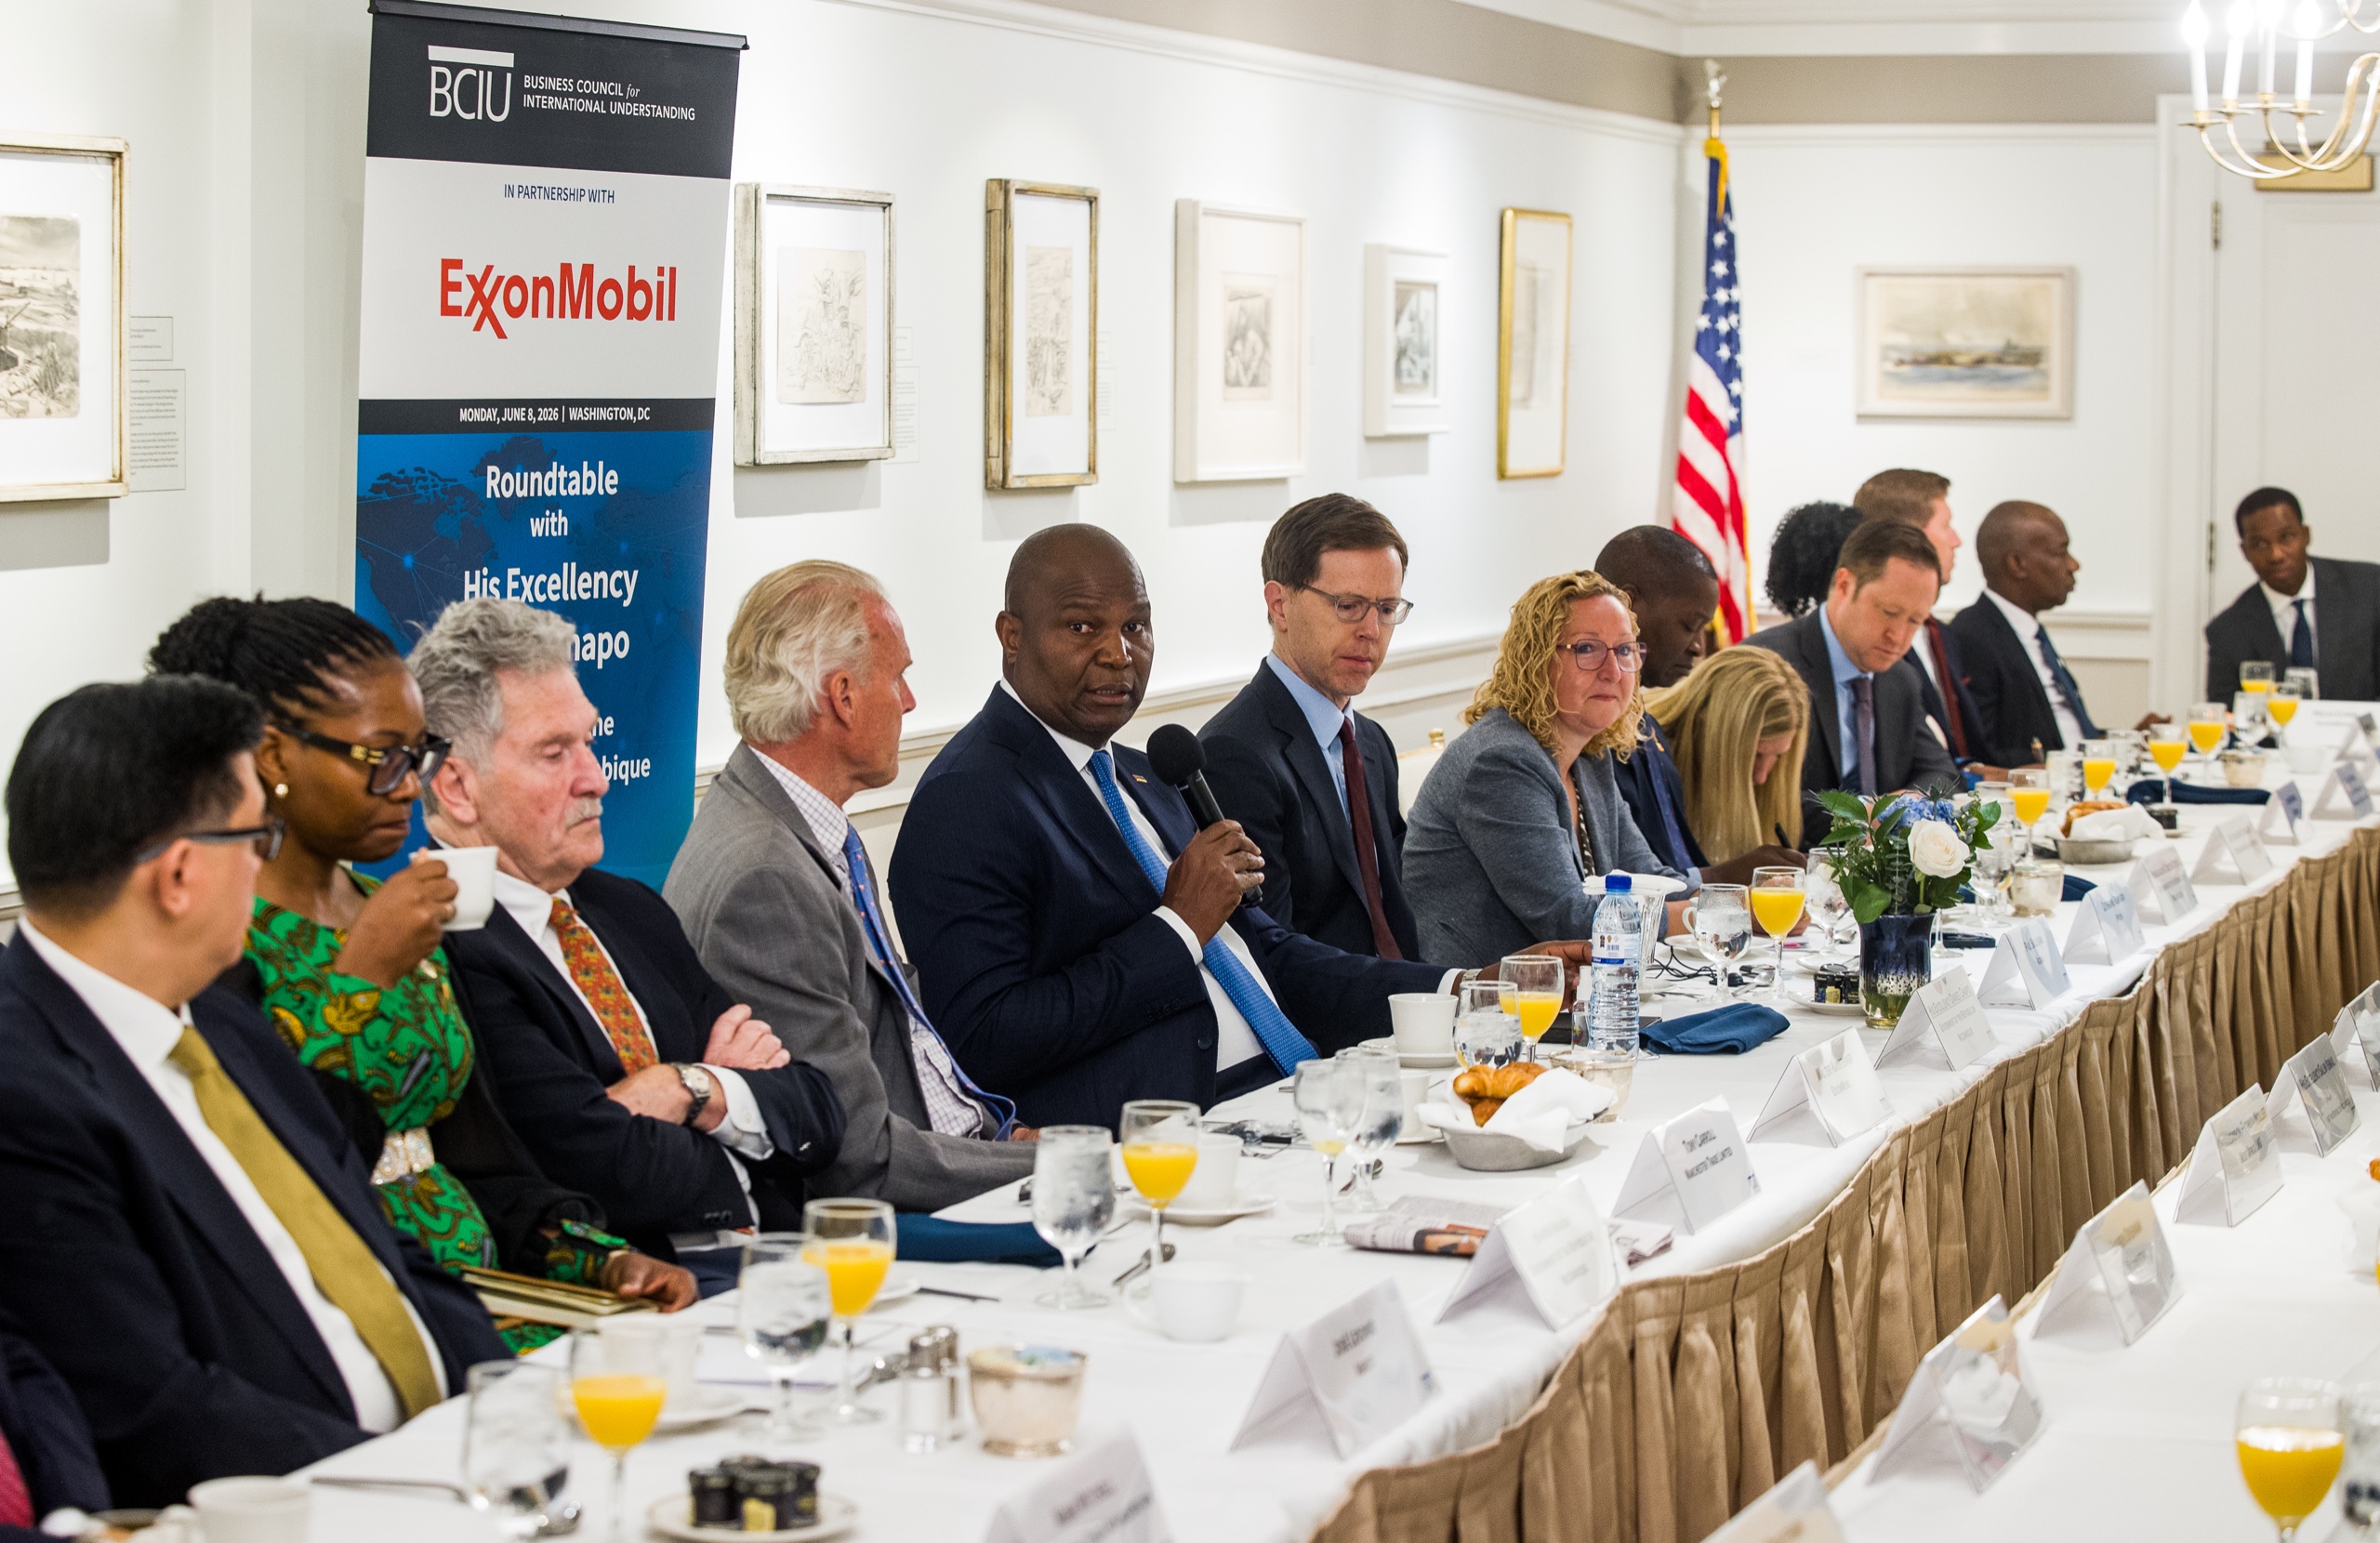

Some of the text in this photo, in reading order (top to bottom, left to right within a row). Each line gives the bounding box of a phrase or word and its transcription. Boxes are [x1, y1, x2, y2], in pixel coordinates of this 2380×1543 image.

[430, 66, 511, 123] BCIU
[523, 74, 641, 99] BUSINESS COUNCIL for
[523, 94, 695, 121] INTERNATIONAL UNDERSTANDING
[504, 184, 615, 204] IN PARTNERSHIP WITH
[440, 257, 677, 339] ExxonMobil
[459, 406, 651, 424] MONDAY, JUNE 8, 2026 WASHINGTON, DC
[486, 461, 619, 499] Roundtable
[530, 509, 569, 538] with
[507, 561, 639, 608] Excellency
